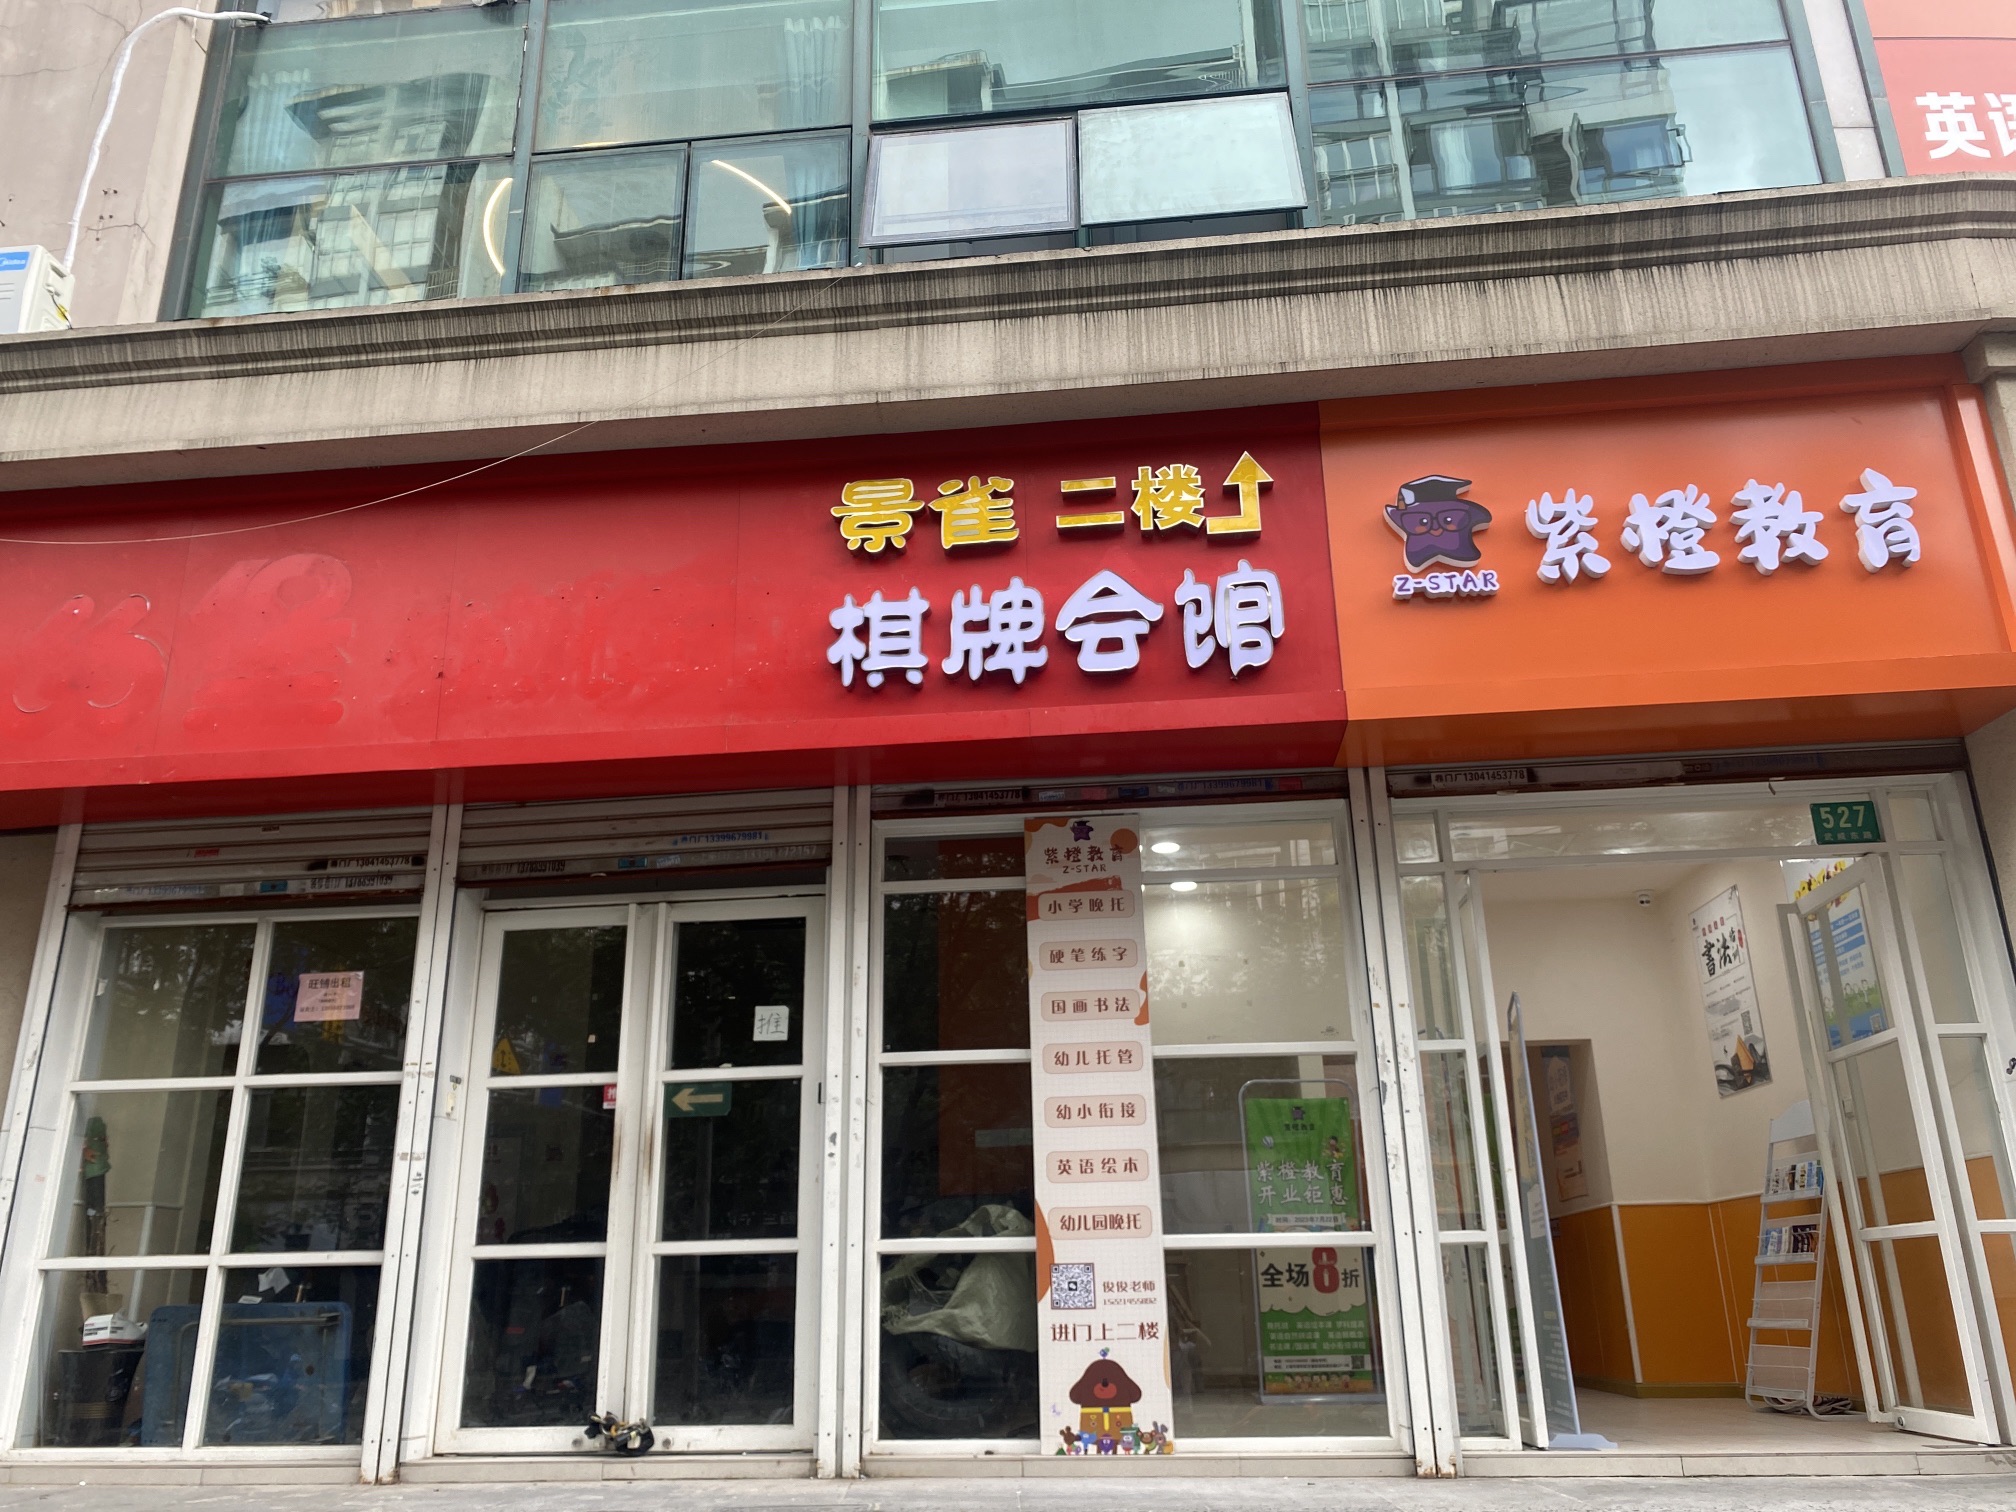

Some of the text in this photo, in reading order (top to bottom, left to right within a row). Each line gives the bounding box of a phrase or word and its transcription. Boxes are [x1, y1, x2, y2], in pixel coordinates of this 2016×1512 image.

[831, 464, 1206, 554] 景雀 二楼
[1524, 467, 1922, 586] 紫橙教育
[1396, 570, 1500, 598] Z-STAR
[826, 559, 1286, 688] 棋牌会馆
[1819, 805, 1865, 829] 527
[1044, 844, 1123, 865] 紫橙教育
[1062, 864, 1107, 874] Z-STAR
[1048, 897, 1126, 915] 小学晚托
[1049, 946, 1128, 964] 硬笔练字
[1051, 997, 1130, 1014] 国画书法
[757, 1013, 785, 1034] 推
[1054, 1049, 1133, 1067] 幼儿托管
[1056, 1102, 1136, 1120] 幼小衔接
[1056, 1157, 1139, 1175] 英语绘本
[1257, 1158, 1346, 1182] 紫橙教育
[1258, 1183, 1348, 1207] 开业钜惠
[1060, 1213, 1142, 1231] 幼儿园晚托
[1261, 1247, 1360, 1294] 全场8折
[1102, 1280, 1156, 1293] 俊俊老师
[1050, 1321, 1160, 1342] 进门上二楼
